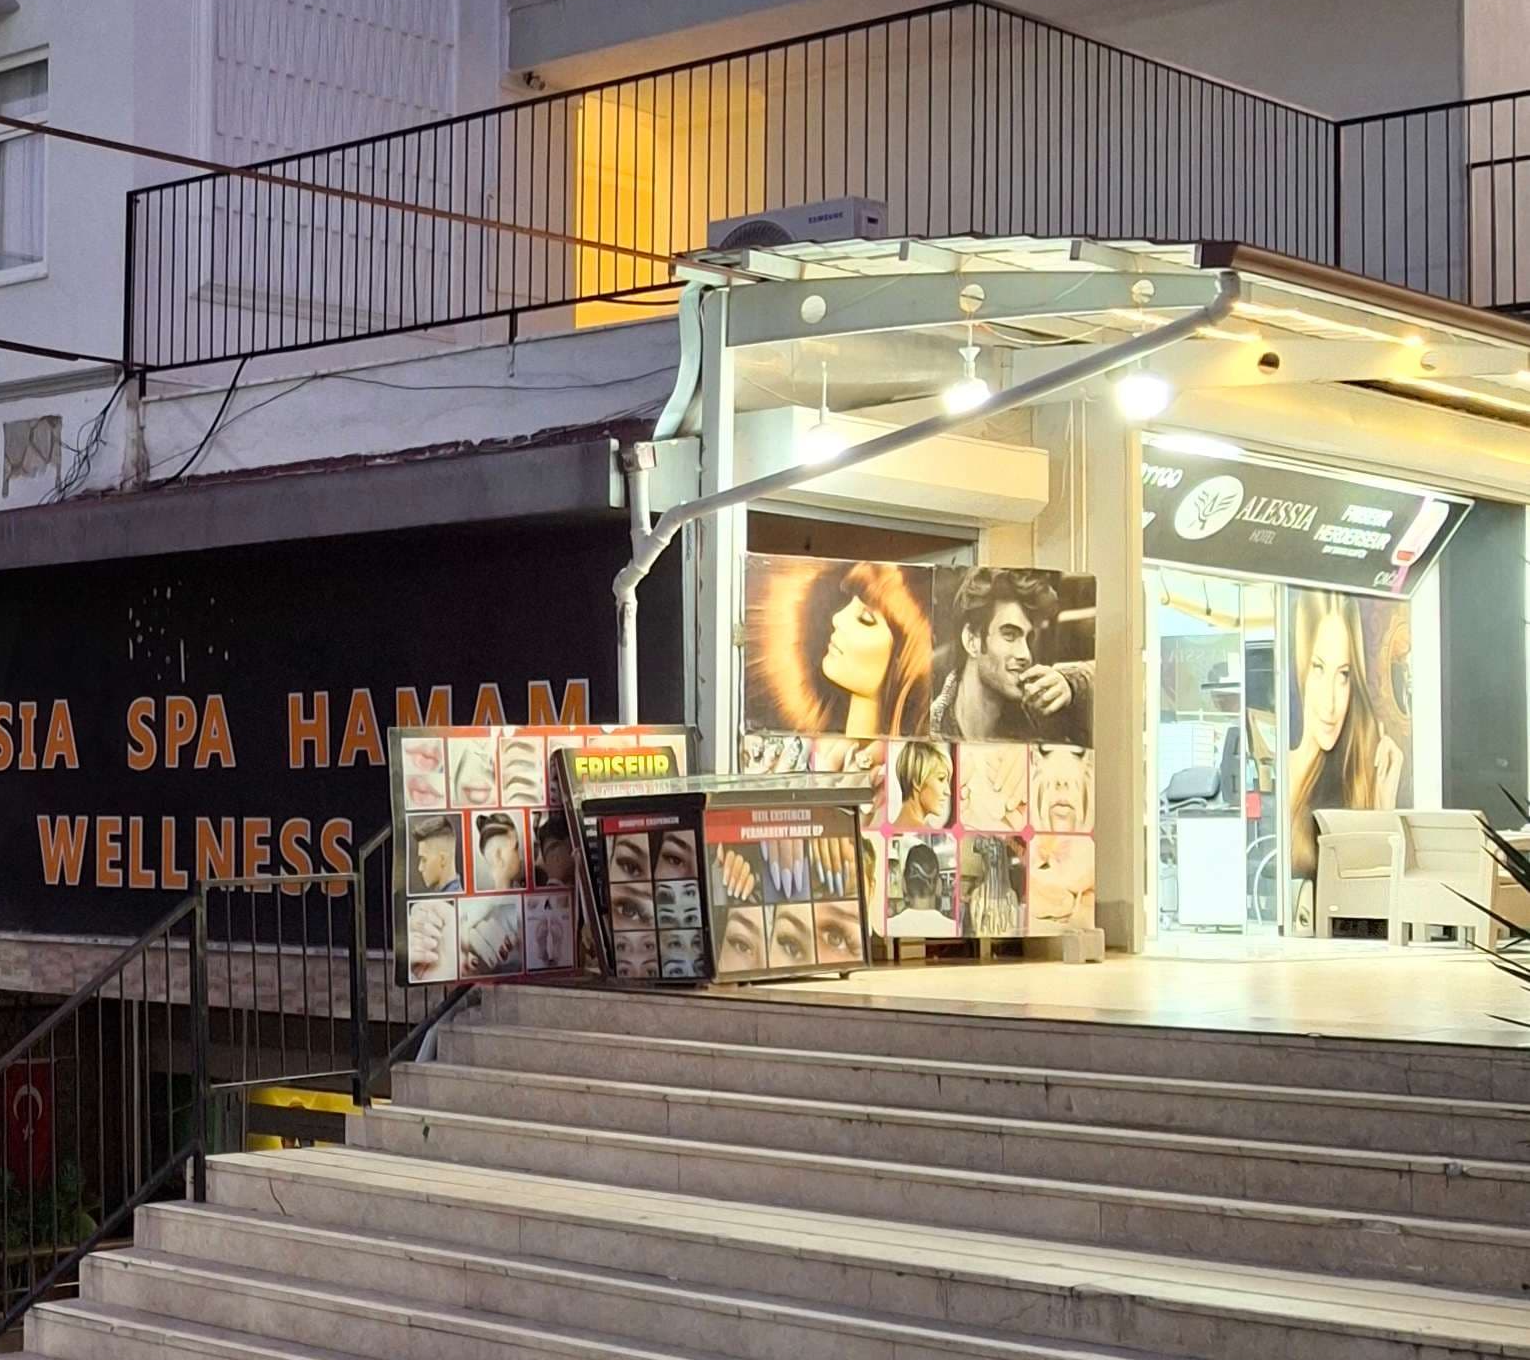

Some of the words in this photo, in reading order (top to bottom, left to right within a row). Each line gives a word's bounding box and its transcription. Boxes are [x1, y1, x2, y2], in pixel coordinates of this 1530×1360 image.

[1235, 495, 1319, 532] ALESSIA
[126, 693, 237, 771] SPA
[575, 754, 670, 781] FRISEUR
[36, 815, 354, 898] WELLNESS
